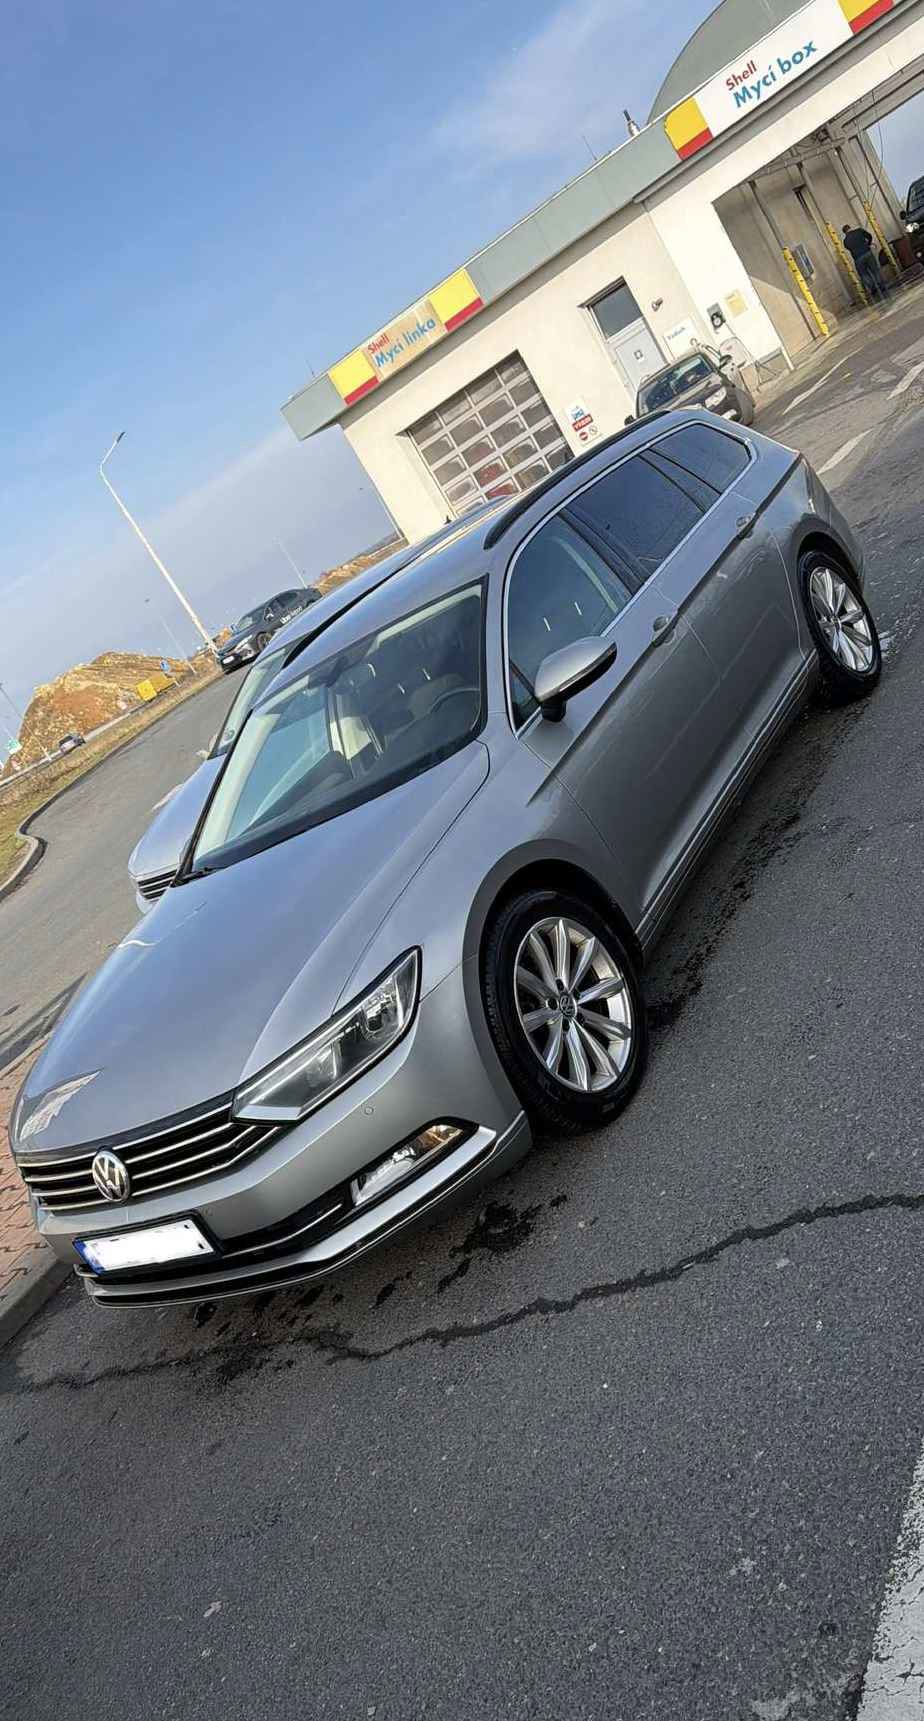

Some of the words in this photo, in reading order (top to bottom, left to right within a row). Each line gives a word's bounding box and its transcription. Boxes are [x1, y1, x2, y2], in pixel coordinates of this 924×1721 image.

[725, 60, 758, 91] Shell
[733, 66, 777, 108] Mycí
[777, 41, 817, 74] box
[367, 333, 390, 353] Shell
